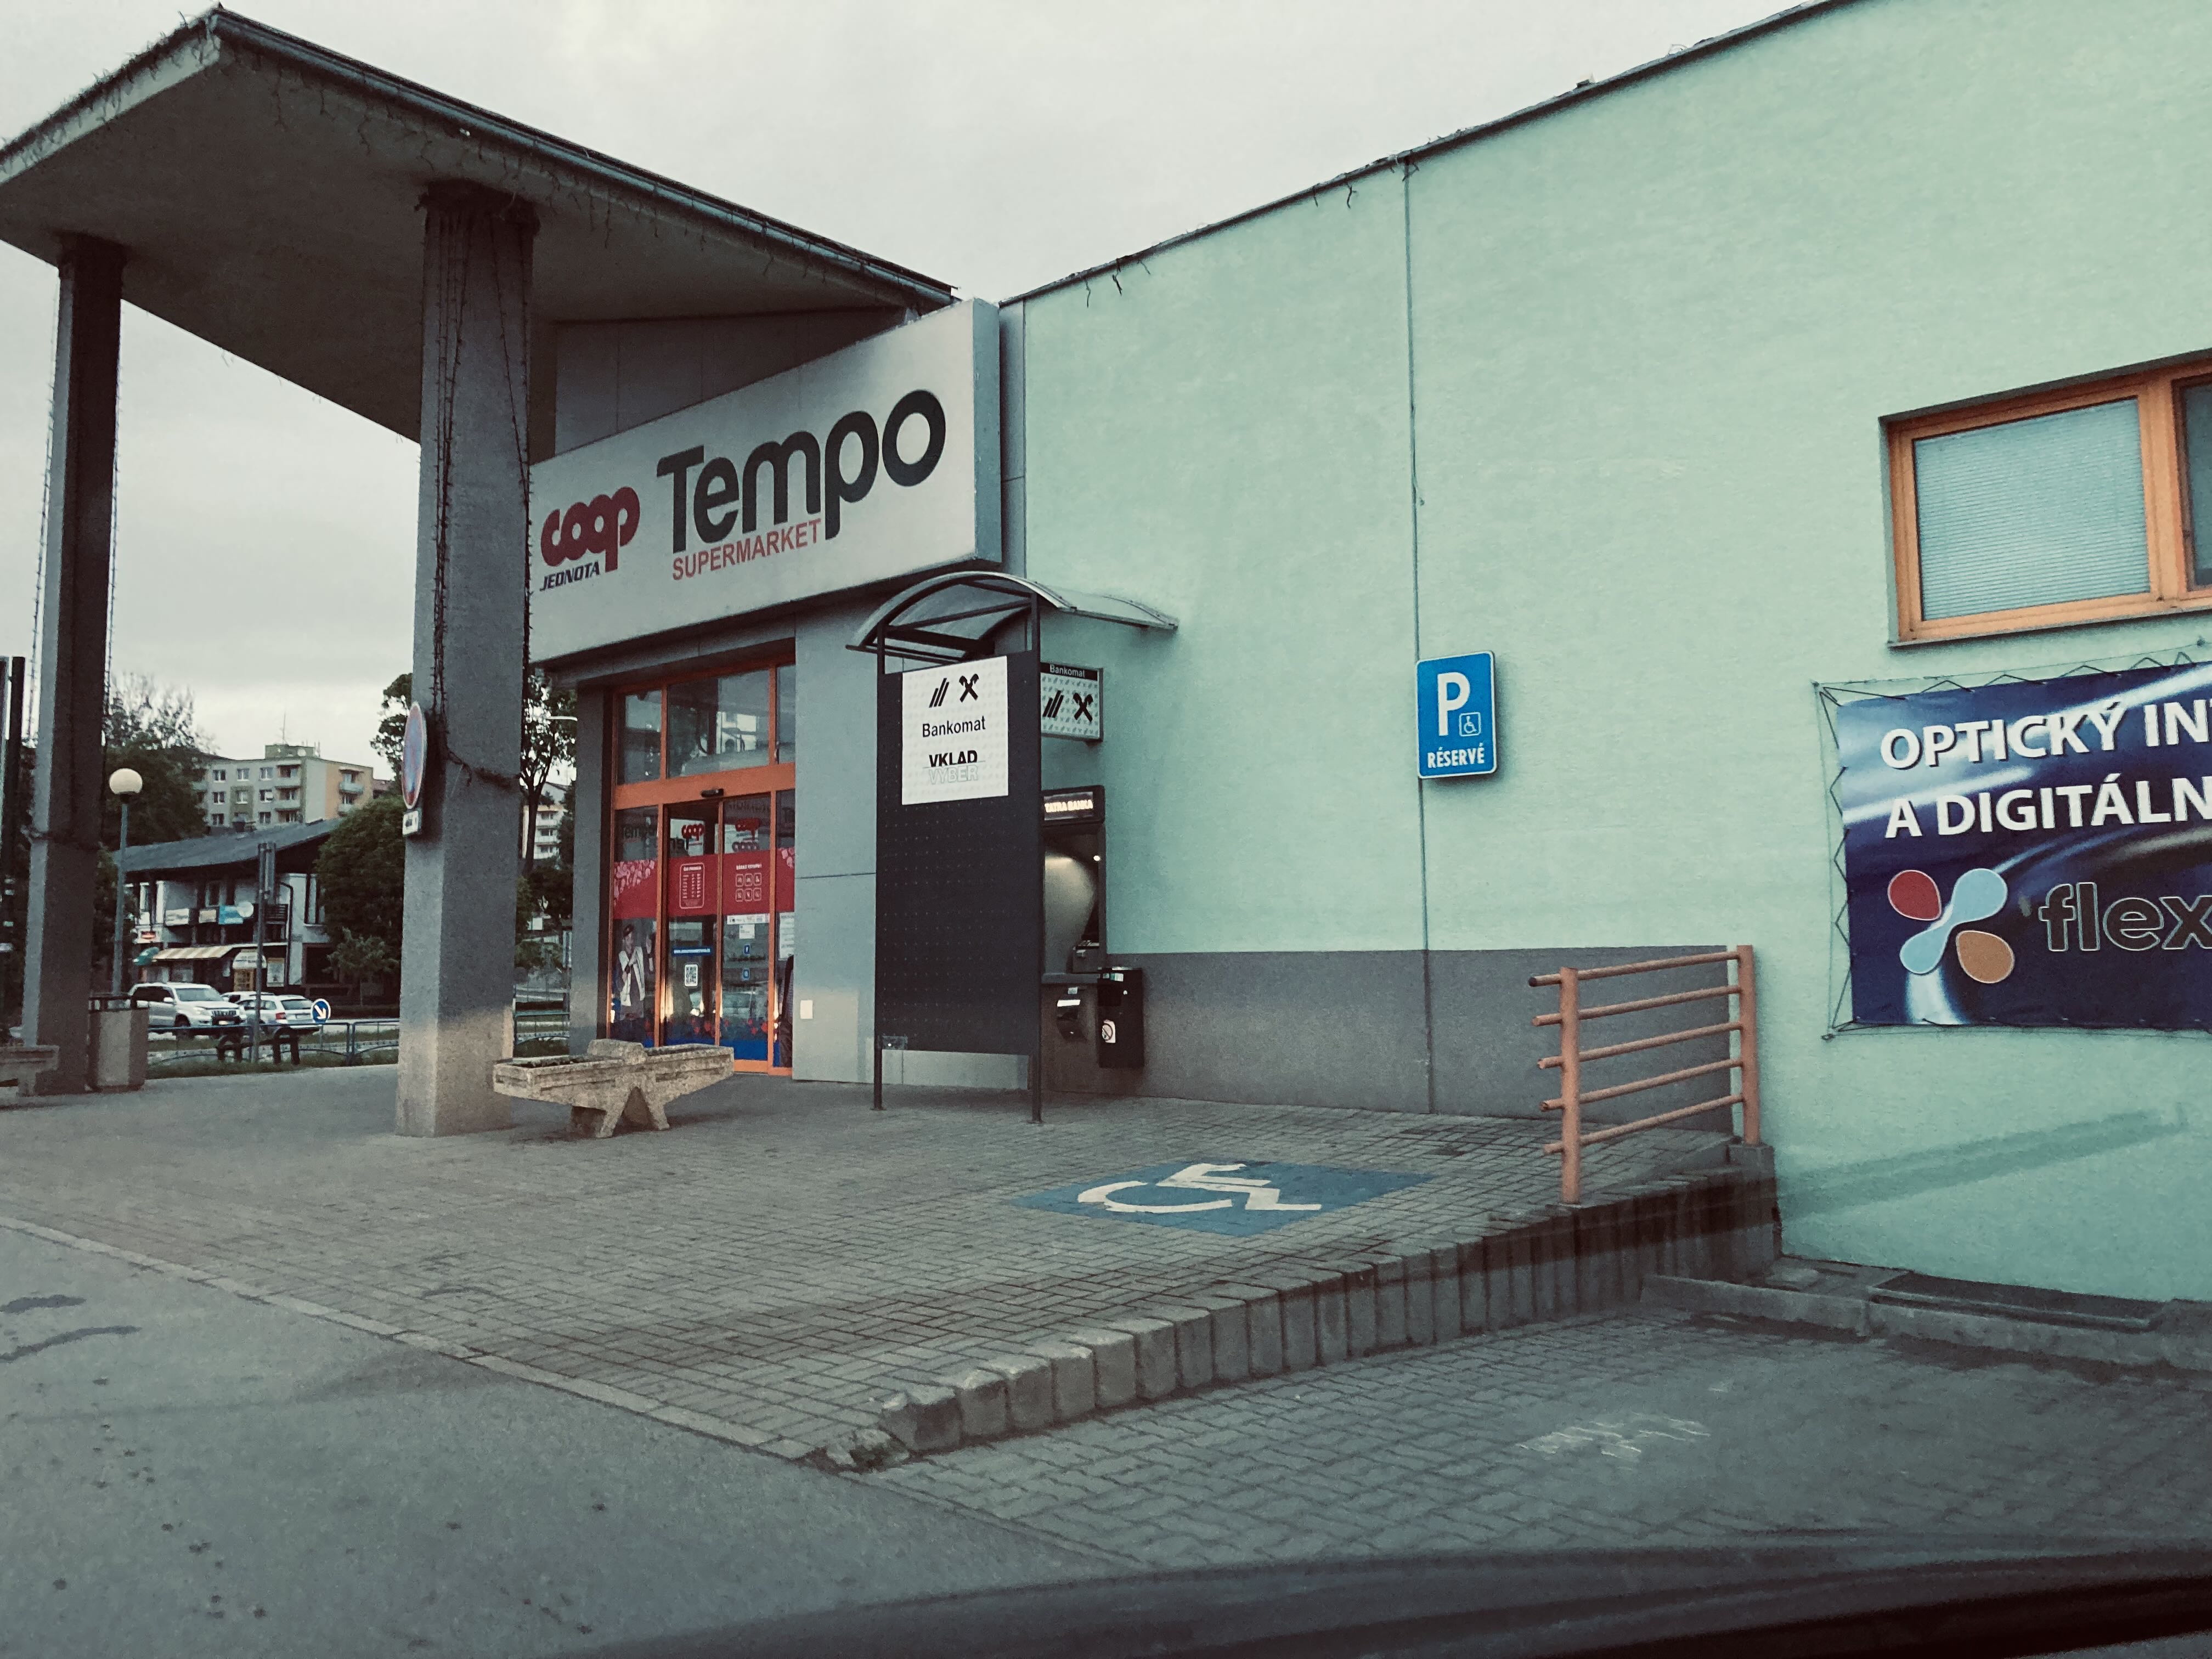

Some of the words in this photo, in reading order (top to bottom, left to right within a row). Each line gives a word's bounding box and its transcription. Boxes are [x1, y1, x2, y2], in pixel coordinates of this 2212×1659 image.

[658, 390, 946, 554] Tempo
[540, 487, 640, 572] coop
[673, 518, 821, 580] SUPERMARKET
[539, 562, 600, 591] JEDNOTA
[1049, 664, 1085, 678] Bankomat
[922, 715, 986, 738] Bankomat
[1437, 672, 1470, 736] P
[1427, 742, 1485, 769] RÉSERVÉ
[1880, 701, 2128, 770] OPTICKÝ
[2144, 699, 2212, 747] IN
[929, 750, 978, 768] VKLAD
[929, 765, 978, 785] VYBER
[1884, 798, 1922, 838] A
[1936, 772, 2212, 836] DIGITÁLN
